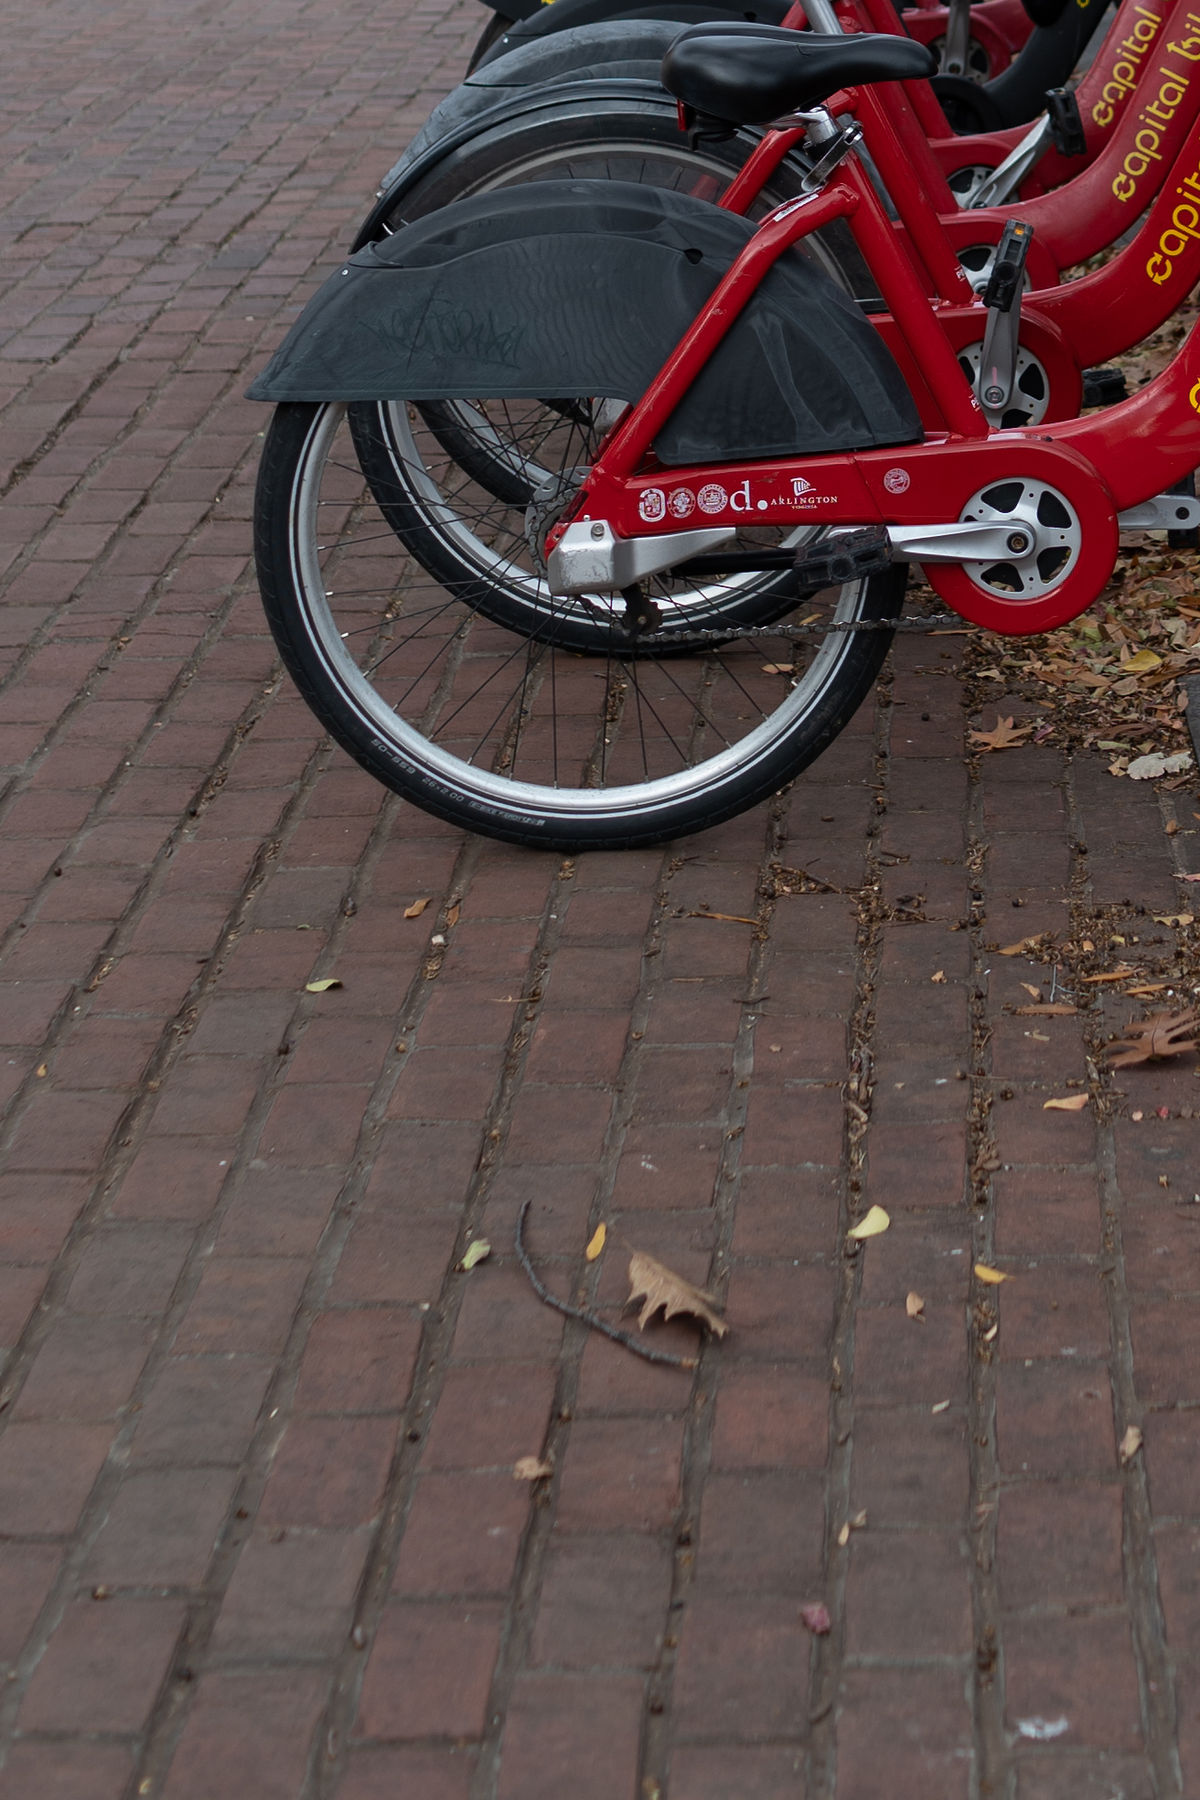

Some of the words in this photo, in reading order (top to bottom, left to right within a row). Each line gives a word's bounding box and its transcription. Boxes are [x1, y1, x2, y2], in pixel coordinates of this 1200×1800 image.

[1092, 5, 1162, 127] capital
[1111, 67, 1190, 202] capital
[770, 494, 839, 506] ARLINGTON
